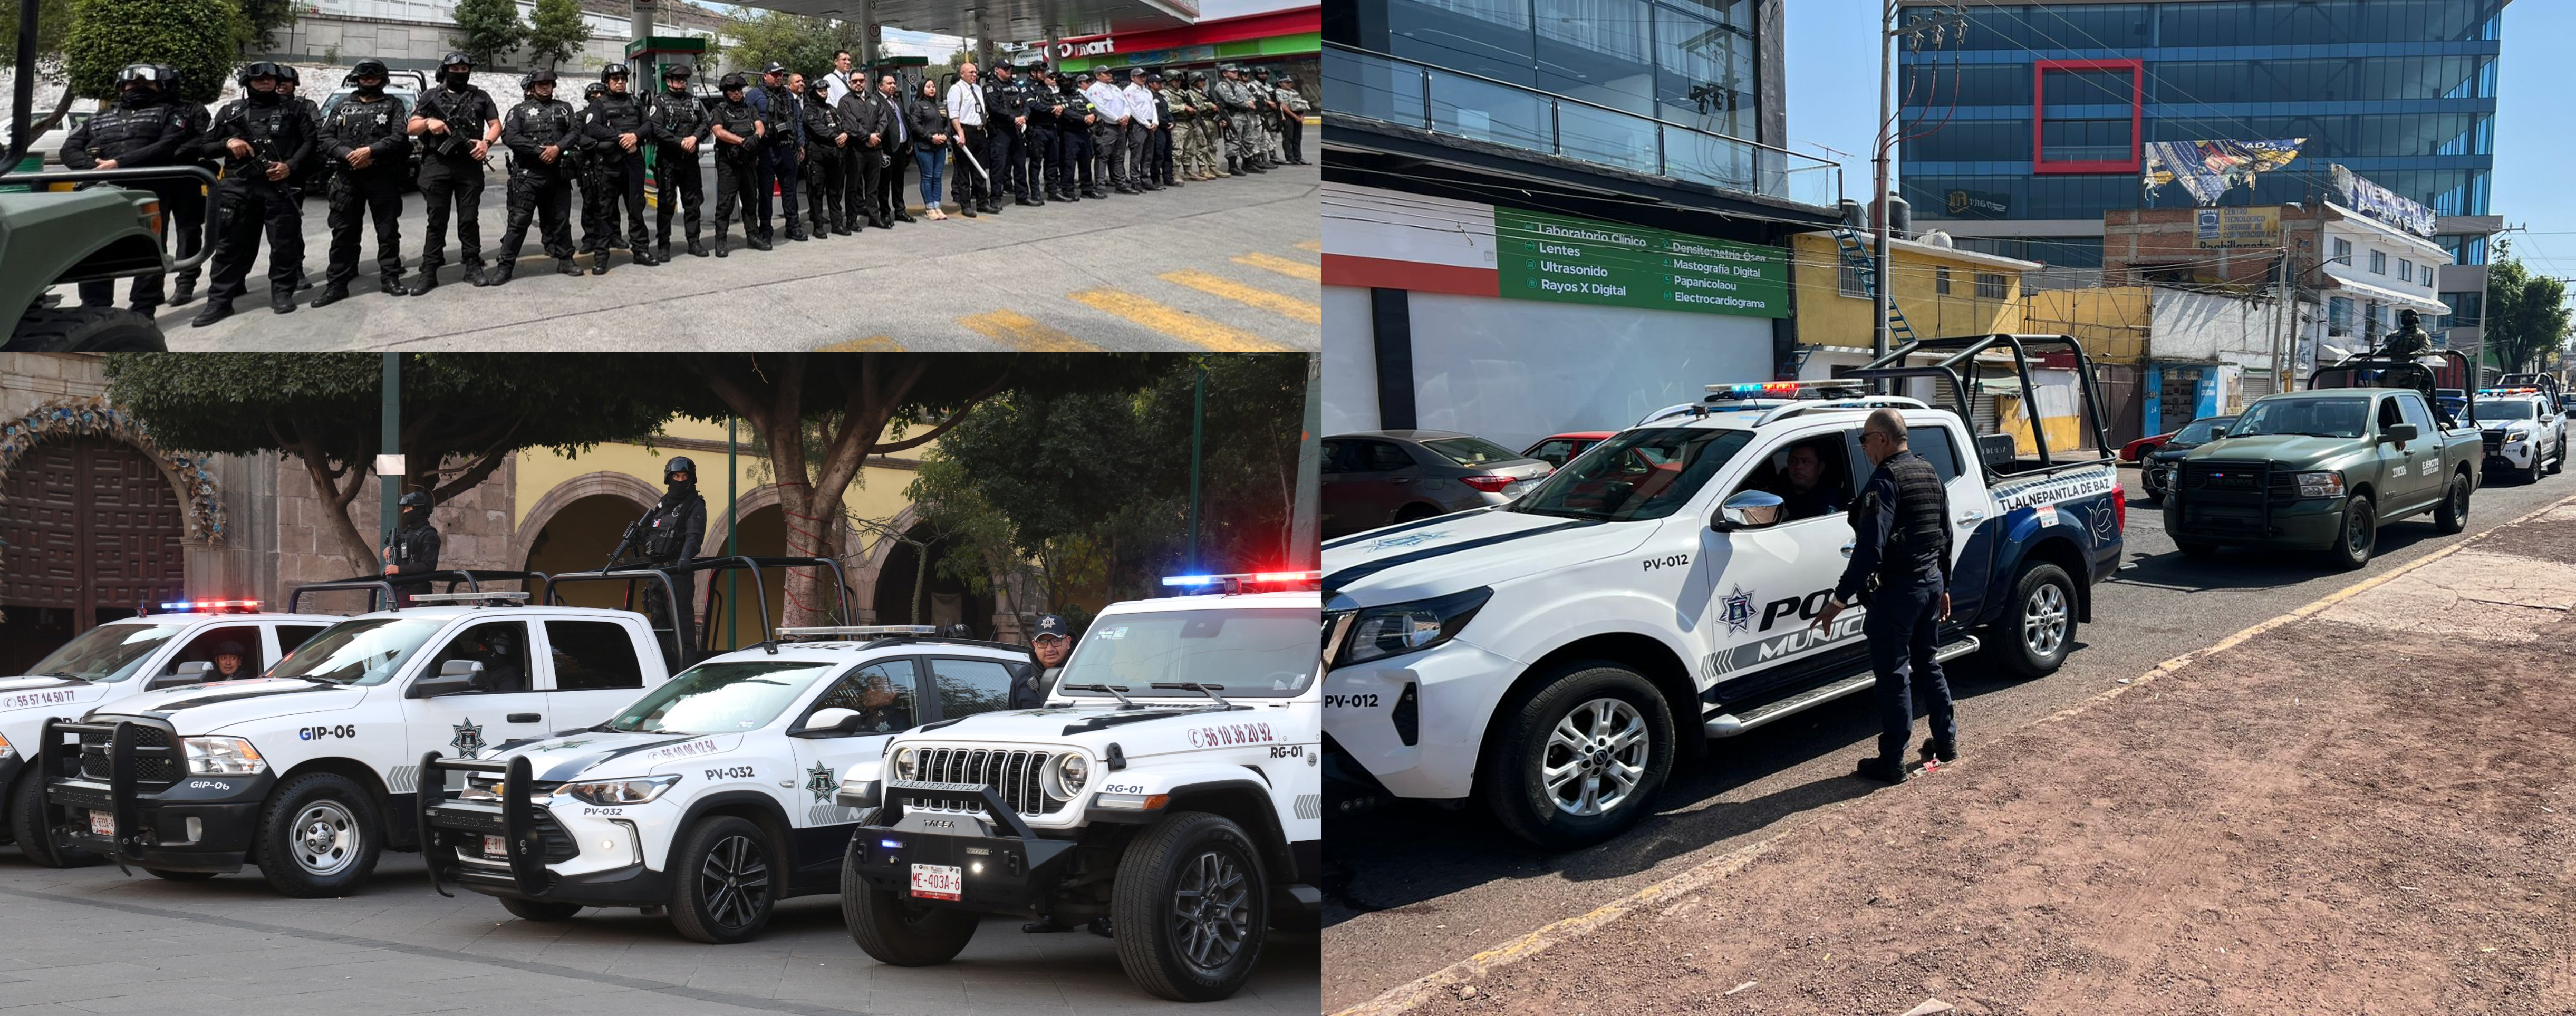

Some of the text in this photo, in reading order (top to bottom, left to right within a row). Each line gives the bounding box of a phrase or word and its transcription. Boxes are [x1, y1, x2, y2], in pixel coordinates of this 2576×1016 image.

[1074, 37, 1114, 56] mart
[1538, 224, 1646, 247] Laboratorio Clínico
[1539, 242, 1580, 257] Lentes
[1673, 242, 1740, 260] Densitometría
[1540, 260, 1608, 277] Ultrasonido
[1673, 259, 1760, 278] Mastografía Digital
[1541, 279, 1626, 297] Rayos X Digital
[1674, 275, 1736, 291] Papanicolaou
[1675, 292, 1765, 308] Electrocardiograma
[1999, 485, 2080, 511] TLALNEPANTLA
[2080, 482, 2093, 495] DE
[2093, 478, 2110, 492] BAZ
[1643, 554, 1689, 572] PV-012
[17, 690, 75, 707] 55 57 14 50 77
[1324, 694, 1379, 708] PV-012
[298, 724, 356, 741] GIP-06
[1202, 722, 1273, 747] 56 10 36 20 92
[661, 748, 674, 759] 56
[673, 746, 686, 758] 10
[695, 741, 707, 754] 12
[705, 739, 718, 752] 54
[1270, 746, 1303, 759] RG-01
[705, 766, 755, 781] PV-032
[893, 780, 982, 791] TLALNEPANTLA
[1105, 783, 1144, 794] RG-01
[923, 819, 955, 828] TACSA
[912, 872, 960, 891] ME-403A-6
